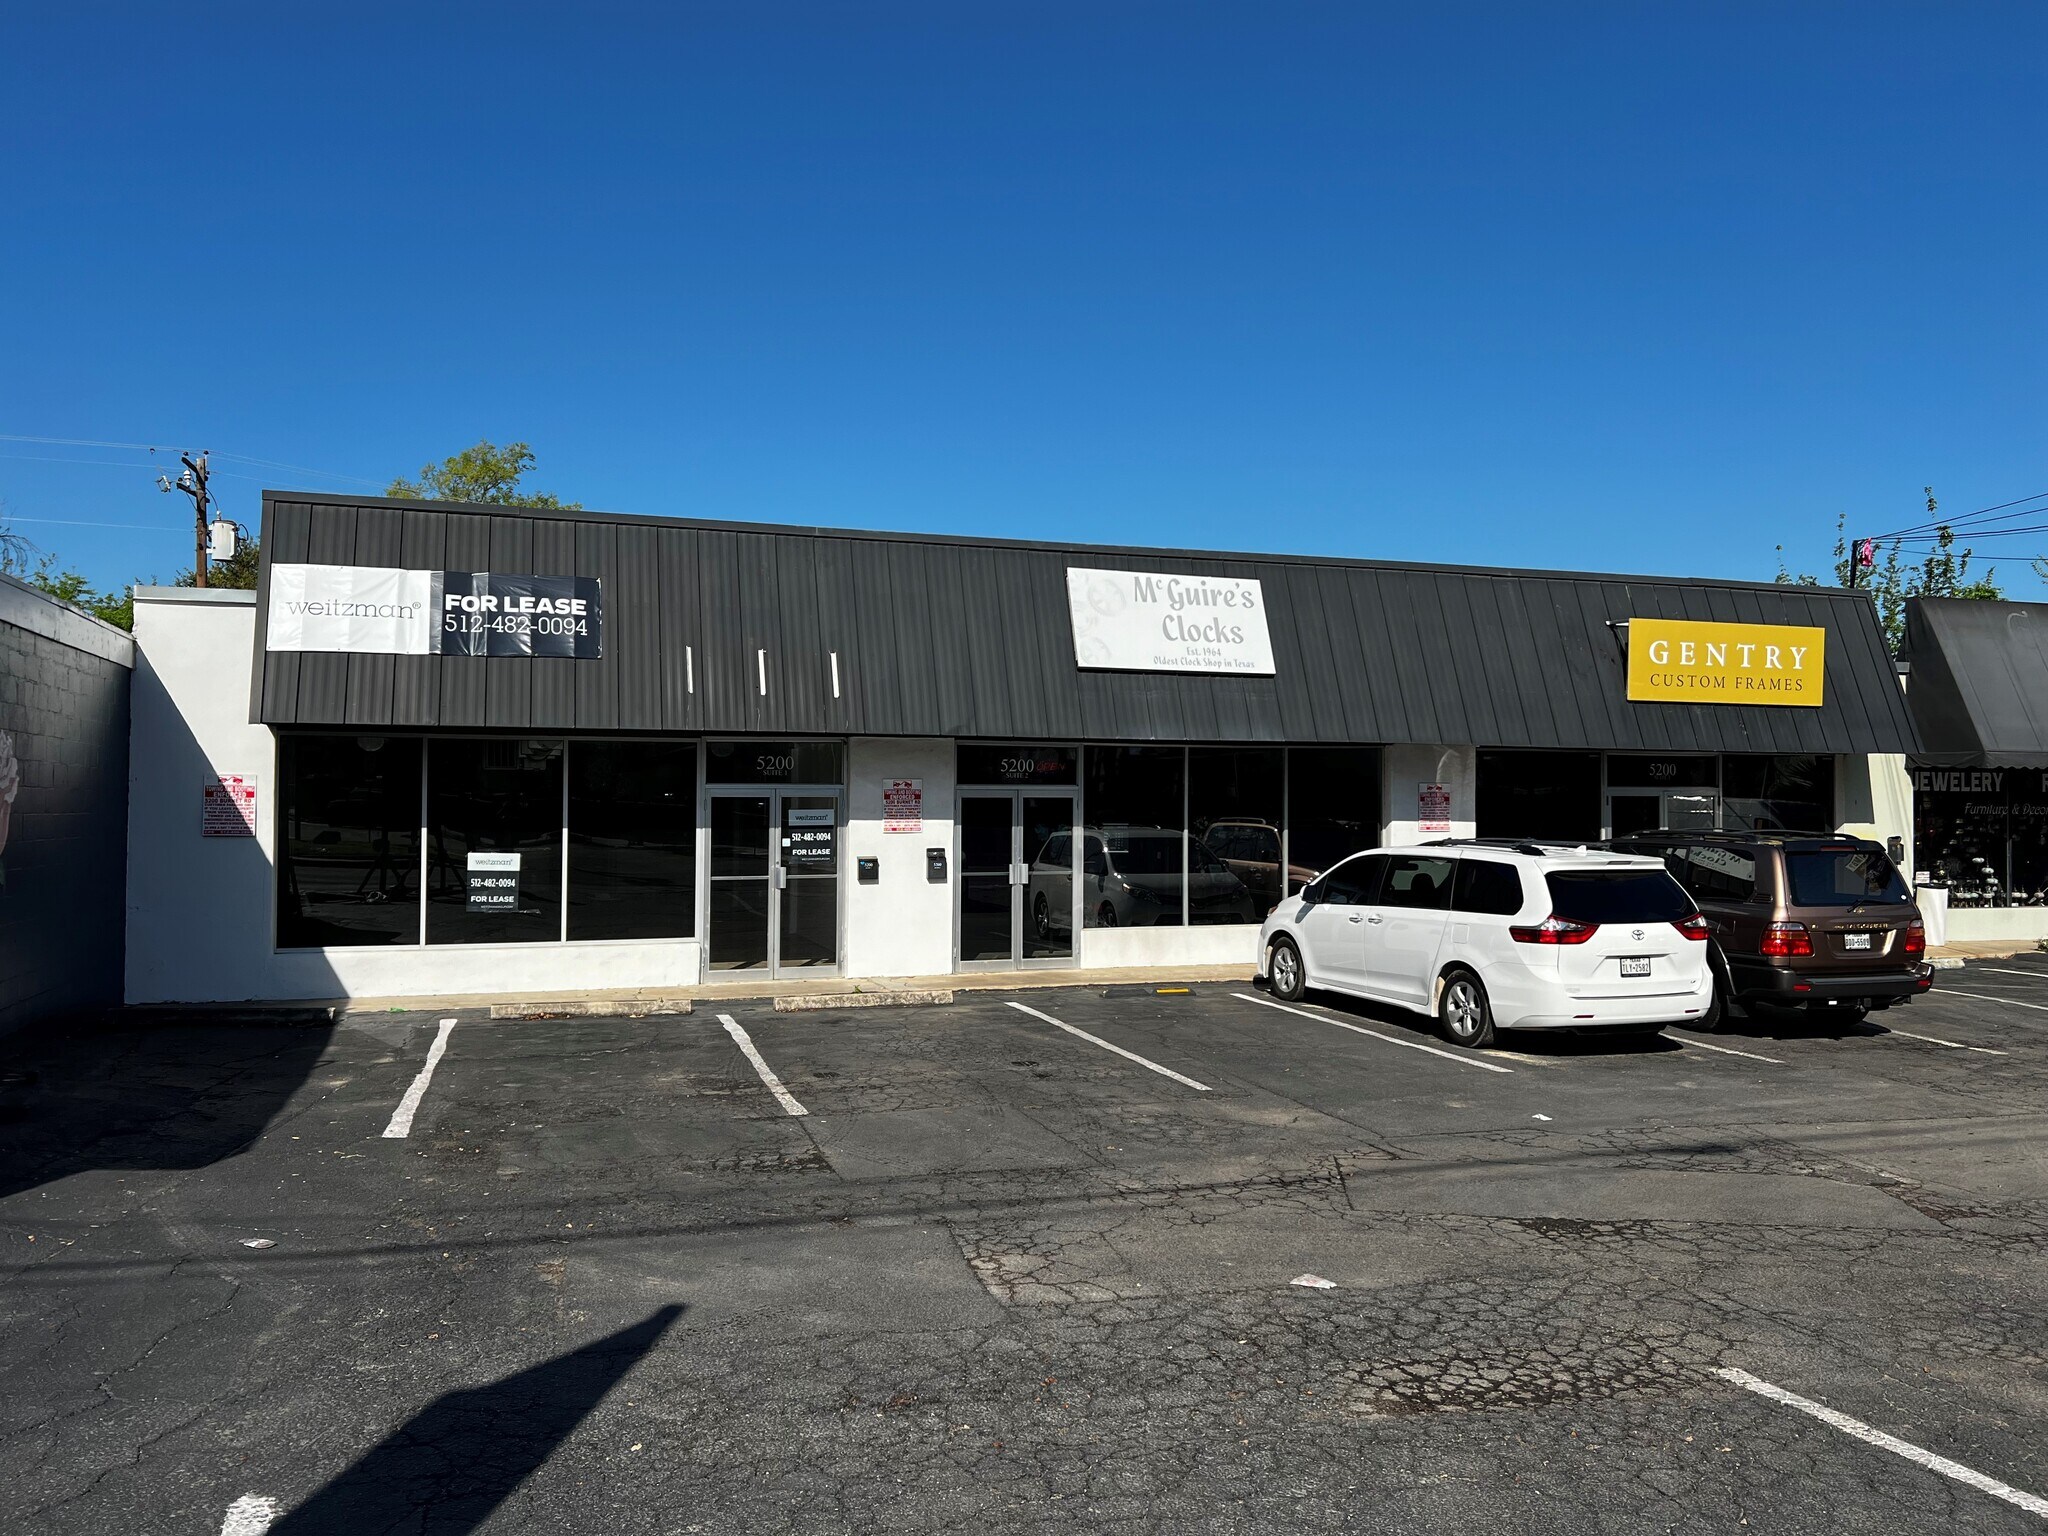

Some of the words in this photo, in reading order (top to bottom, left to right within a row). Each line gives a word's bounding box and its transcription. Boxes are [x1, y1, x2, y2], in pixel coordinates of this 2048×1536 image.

[445, 594, 498, 613] FOR
[503, 596, 586, 616] LEASE
[444, 614, 588, 636] 512-482-0094
[1162, 614, 1244, 644] Clocks
[1186, 647, 1201, 656] Est.
[1203, 647, 1221, 657] 1964
[1649, 640, 1807, 670] GENTRY
[1154, 656, 1178, 665] Oldest
[1180, 657, 1201, 666] Clock
[1204, 658, 1221, 668] Shop
[1224, 659, 1232, 667] in
[1234, 659, 1255, 668] Texas
[1650, 673, 1726, 689] CUSTOM
[1735, 677, 1803, 691] FRAMES
[757, 756, 794, 769] 5200
[1000, 759, 1034, 772] 5200
[1650, 763, 1676, 776] 5200
[1913, 771, 2003, 792] JEWELERY
[1964, 802, 2009, 818] Furniture
[2011, 804, 2020, 815] &
[792, 832, 831, 841] 512-482-0094
[470, 878, 516, 887] 512-482-0094
